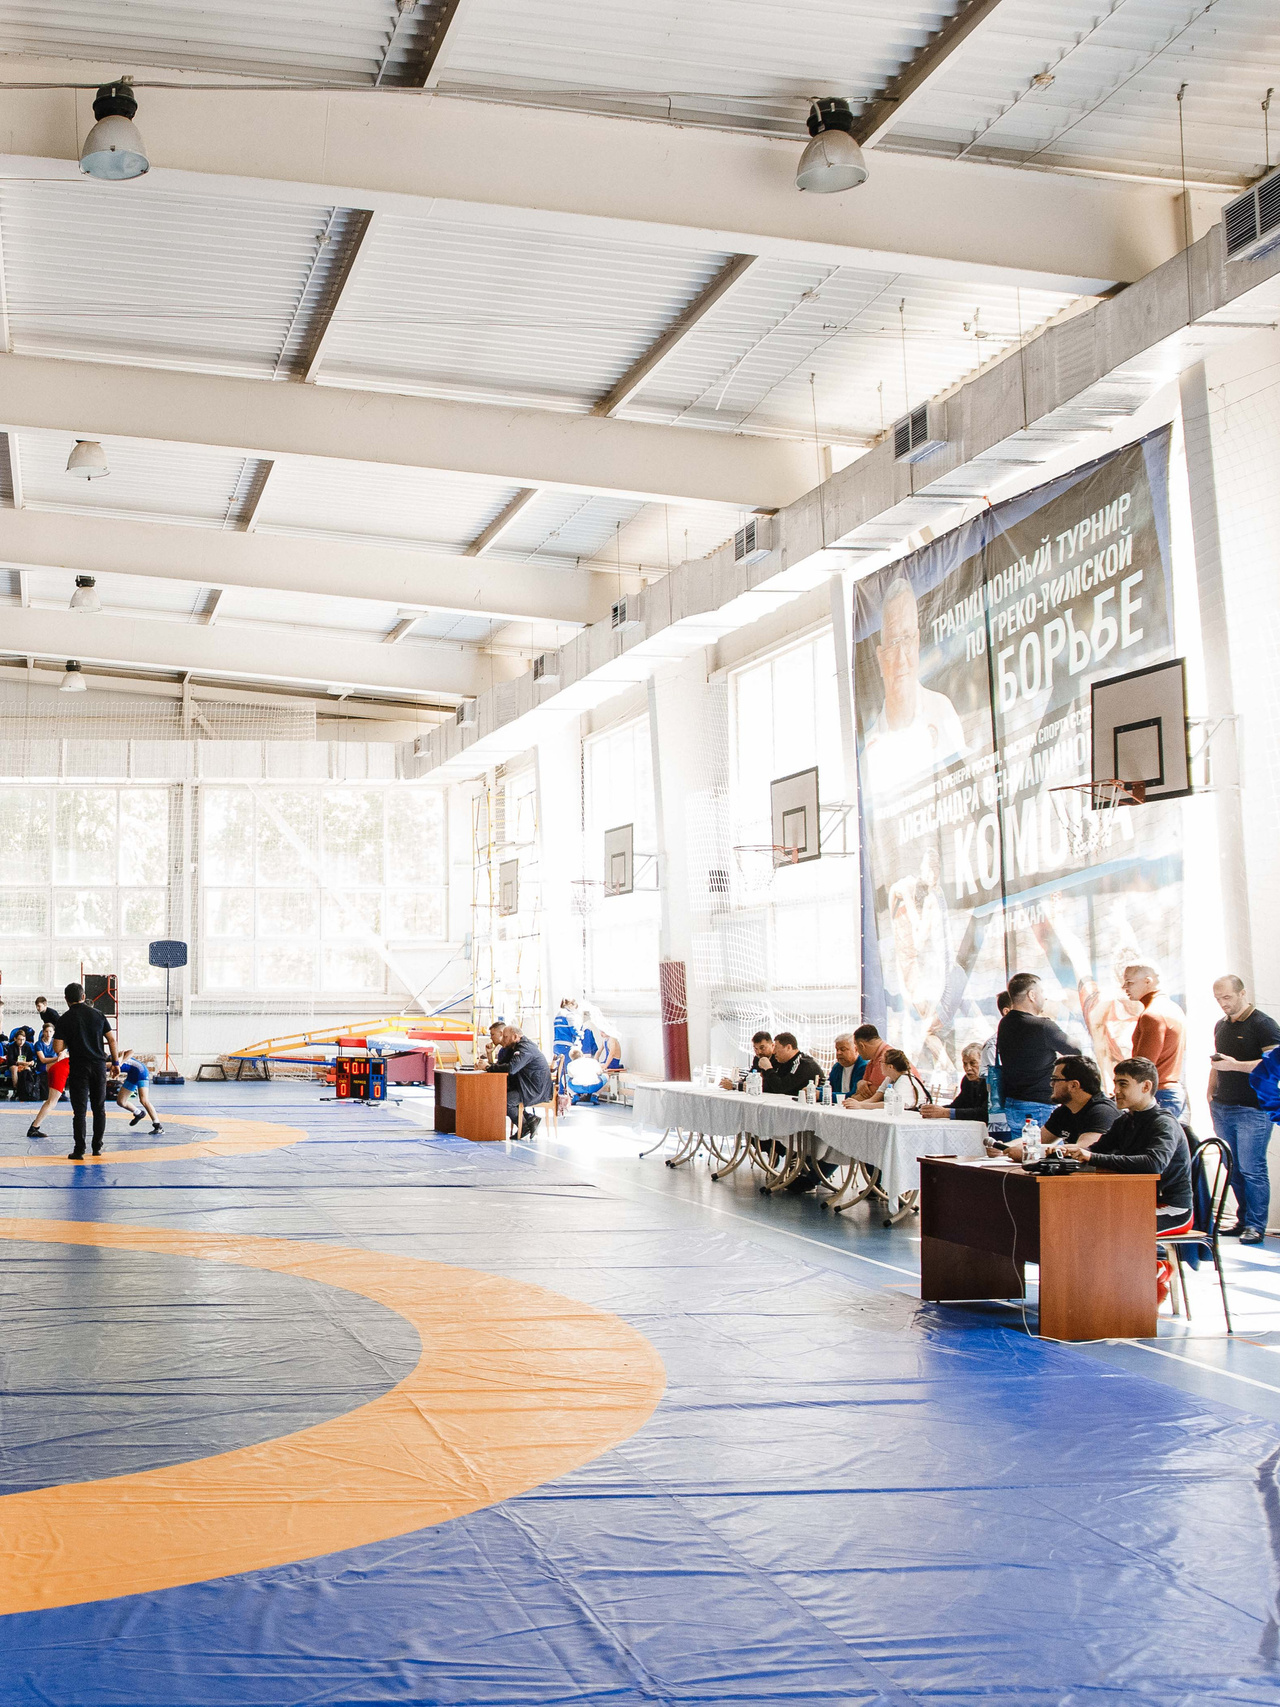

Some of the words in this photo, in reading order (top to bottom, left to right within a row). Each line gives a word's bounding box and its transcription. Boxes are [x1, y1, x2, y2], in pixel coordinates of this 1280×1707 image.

[931, 534, 1052, 646] ТРАДИЦИОННЫЙ
[1056, 492, 1131, 563] ТУРНИР
[965, 624, 987, 662] ПО
[989, 526, 1133, 648] ГРЕКО-РИМСКОЙ
[997, 569, 1144, 714] БОРЬБЕ
[340, 1083, 347, 1096] 0
[343, 1062, 350, 1074] 4
[373, 1085, 381, 1098] 0
